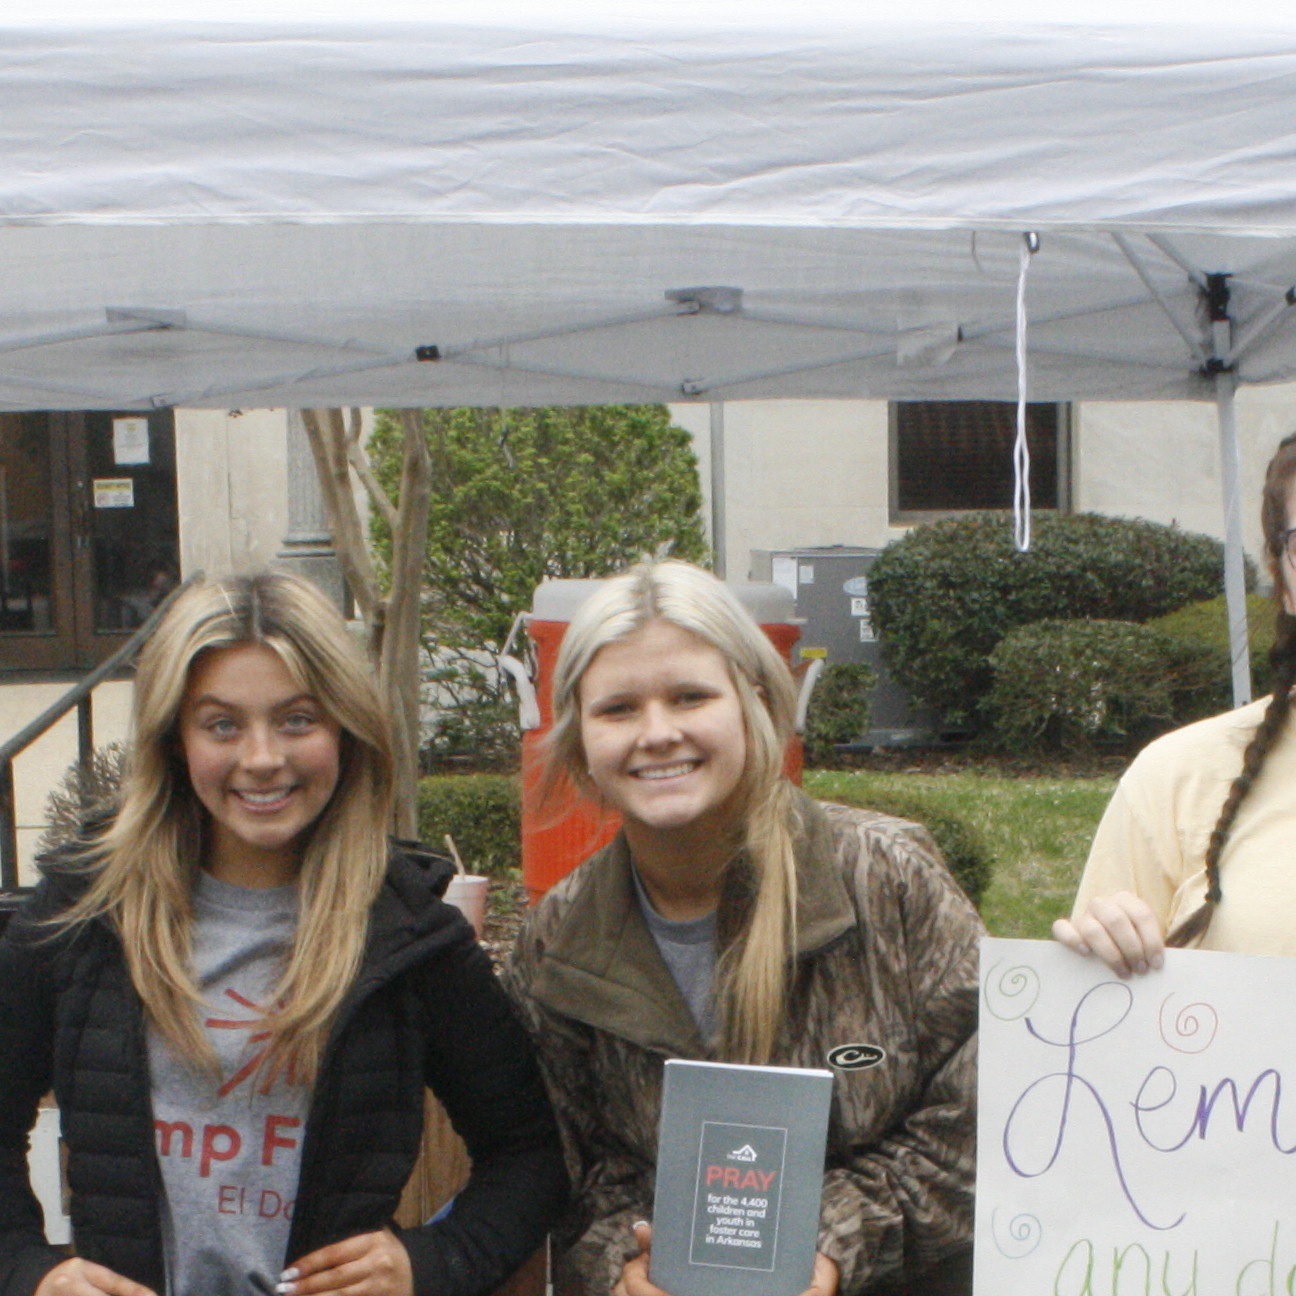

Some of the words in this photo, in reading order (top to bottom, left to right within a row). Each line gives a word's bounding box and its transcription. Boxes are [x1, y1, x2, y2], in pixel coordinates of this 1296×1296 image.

[706, 1164, 778, 1193] PRAY
[217, 1184, 247, 1216] El
[707, 1192, 722, 1204] for
[723, 1195, 739, 1206] the
[707, 1204, 745, 1216] children
[746, 1208, 767, 1219] and
[716, 1216, 744, 1227] youth
[745, 1218, 756, 1228] in
[709, 1223, 738, 1236] foster
[738, 1228, 761, 1239] care
[705, 1233, 716, 1244] in
[716, 1235, 762, 1249] Arkansas
